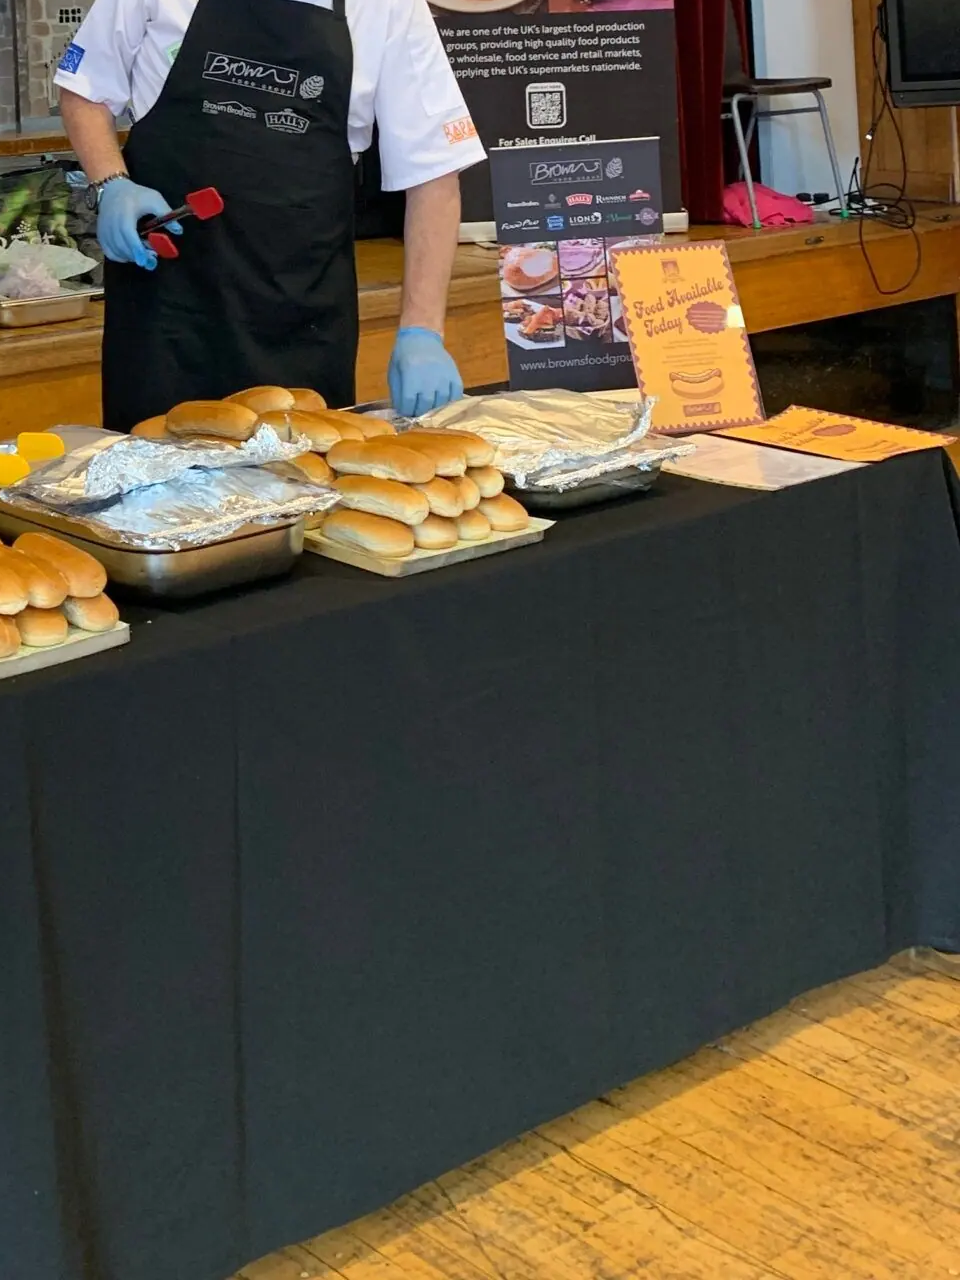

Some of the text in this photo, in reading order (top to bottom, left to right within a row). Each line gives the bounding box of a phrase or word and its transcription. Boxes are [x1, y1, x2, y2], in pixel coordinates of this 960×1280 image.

[440, 22, 645, 37] We are one of the UK's largest food production
[446, 36, 640, 52] groups, providing high quality food products
[457, 53, 504, 63] wholesale,
[505, 52, 526, 62] food
[528, 52, 559, 62] service
[561, 50, 578, 60] and
[580, 49, 603, 59] retail
[605, 49, 642, 58] markets,
[452, 62, 642, 78] upplying the UK's supermarkets nationwide.
[203, 100, 227, 112] Brown
[499, 138, 514, 147] For
[515, 137, 537, 146] Sales
[633, 296, 664, 320] Food
[666, 277, 725, 308] Available
[643, 316, 682, 338] Today
[520, 353, 633, 371] www.brownsfoodgrou
